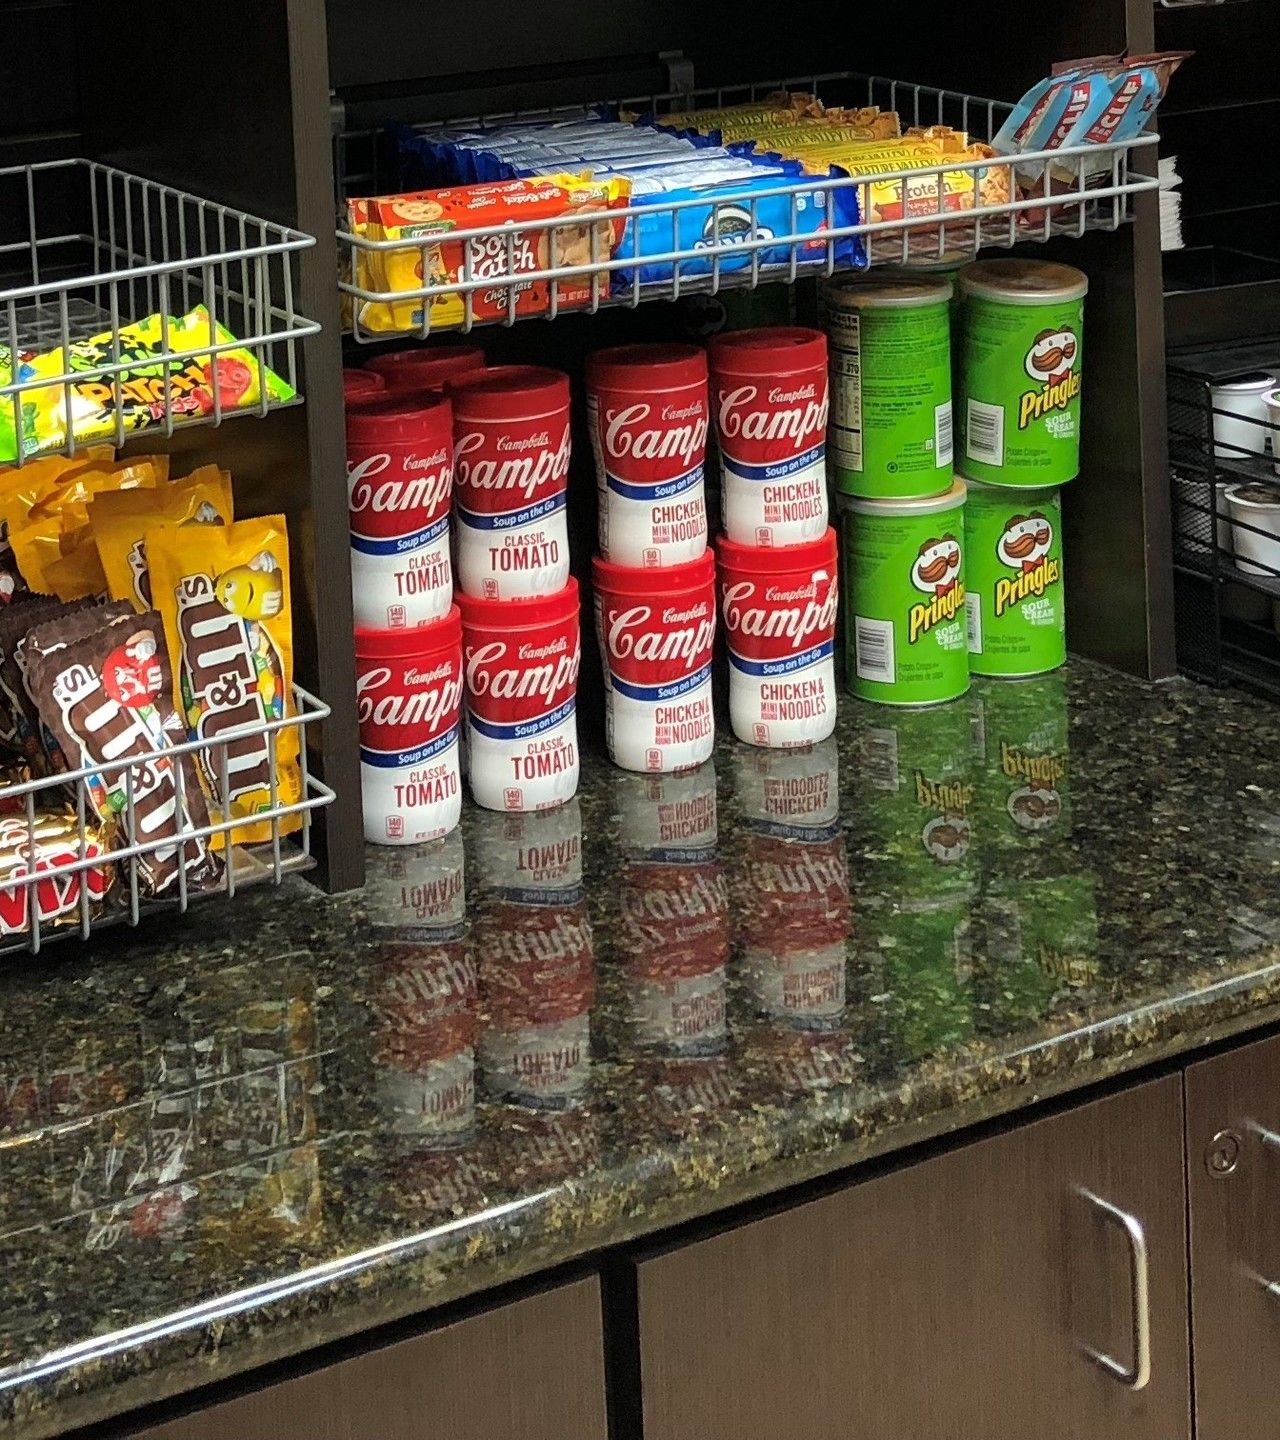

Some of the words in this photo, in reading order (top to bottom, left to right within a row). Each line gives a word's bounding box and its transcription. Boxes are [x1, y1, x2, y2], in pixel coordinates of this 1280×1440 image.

[78, 366, 207, 407] PATCH
[1045, 412, 1072, 426] SOUR
[765, 464, 788, 478] Soup
[789, 462, 801, 472] on
[800, 455, 811, 469] the
[763, 481, 813, 503] CHICKEN
[493, 512, 516, 528] Soup
[517, 511, 529, 522] on
[530, 503, 543, 518] the
[651, 499, 700, 525] CHICKEN
[782, 497, 822, 523] NOODLES
[504, 531, 545, 548] CLASSIC
[652, 526, 670, 537] MINI
[408, 550, 441, 569] CLASSIC
[489, 540, 559, 572] TOMATO
[394, 560, 450, 596] TOMATO
[994, 558, 1059, 615] Pringles
[1021, 598, 1051, 612] SOUR
[934, 622, 962, 636] SOUR
[763, 661, 785, 675] Soup
[786, 658, 797, 669] on
[797, 654, 811, 666] the
[760, 683, 817, 701] CHICKEN
[655, 701, 704, 724] CHICKEN
[778, 696, 826, 721] NOODLES
[672, 716, 712, 745] NOODLES
[527, 735, 564, 754] CLASSIC
[409, 763, 447, 783] CLASSIC
[511, 744, 574, 781] TOMATO
[394, 772, 457, 808] TOMATO
